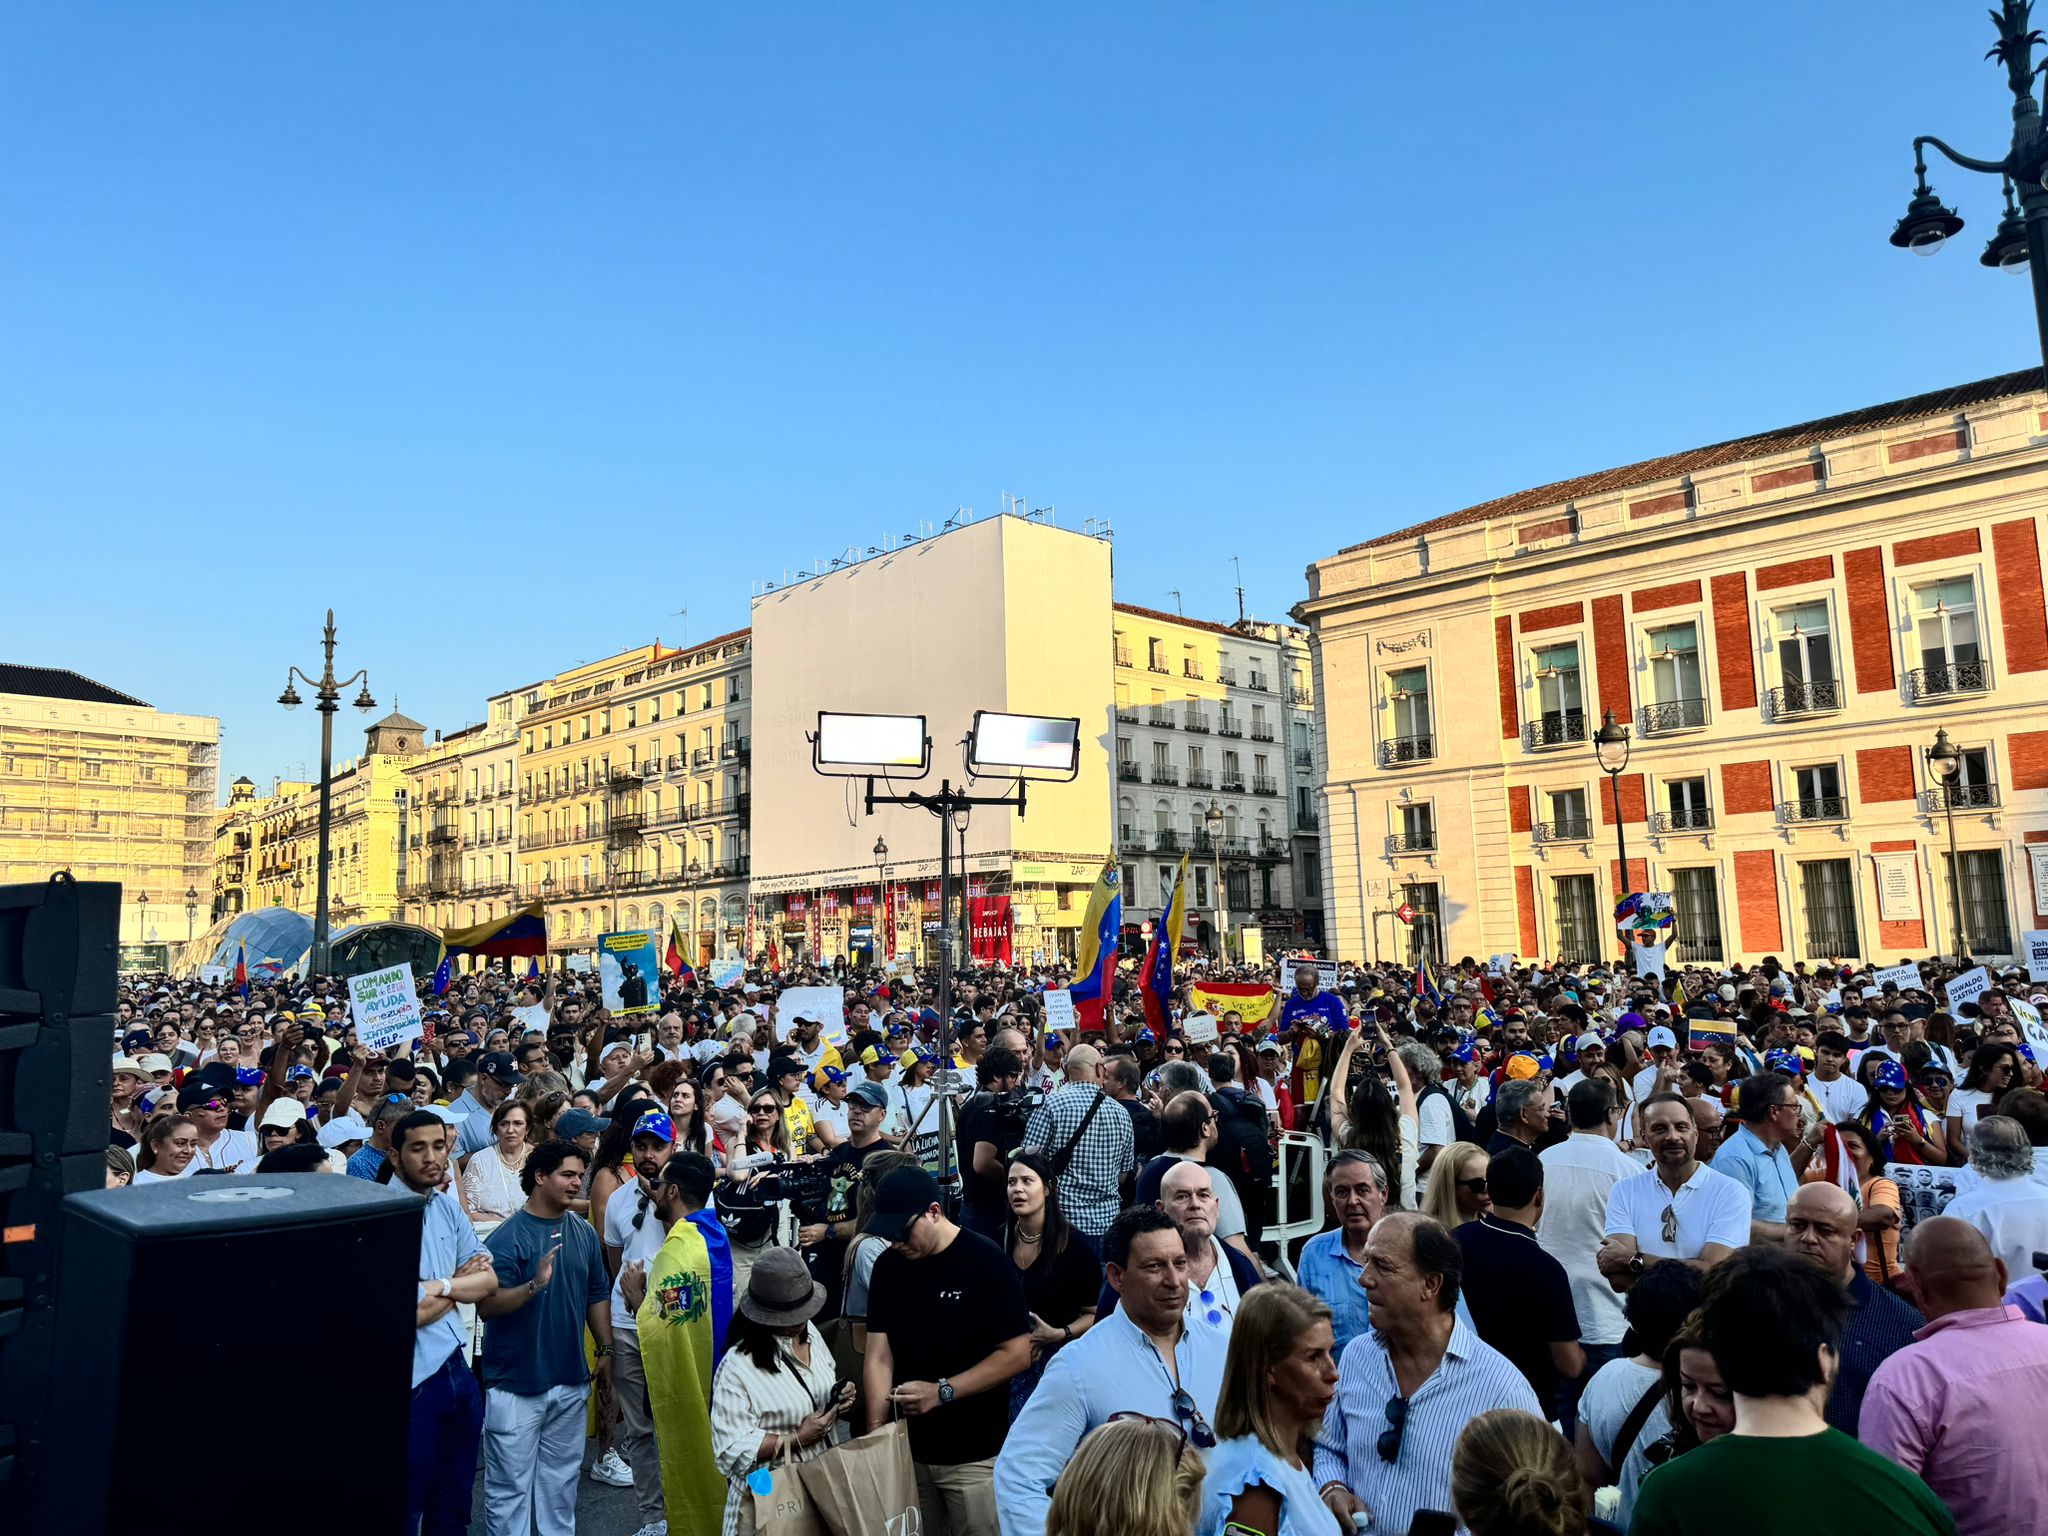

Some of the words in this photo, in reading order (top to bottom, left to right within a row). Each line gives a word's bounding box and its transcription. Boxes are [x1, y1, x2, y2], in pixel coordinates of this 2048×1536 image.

[850, 928, 872, 938] Change
[973, 926, 1008, 938] REBAJAS
[1876, 969, 1907, 980] PUERTA
[1950, 975, 1983, 996] OSWALDO
[356, 988, 378, 1003] SUR
[1953, 984, 1984, 1003] CASTILLO
[365, 992, 407, 1014] AYUDA
